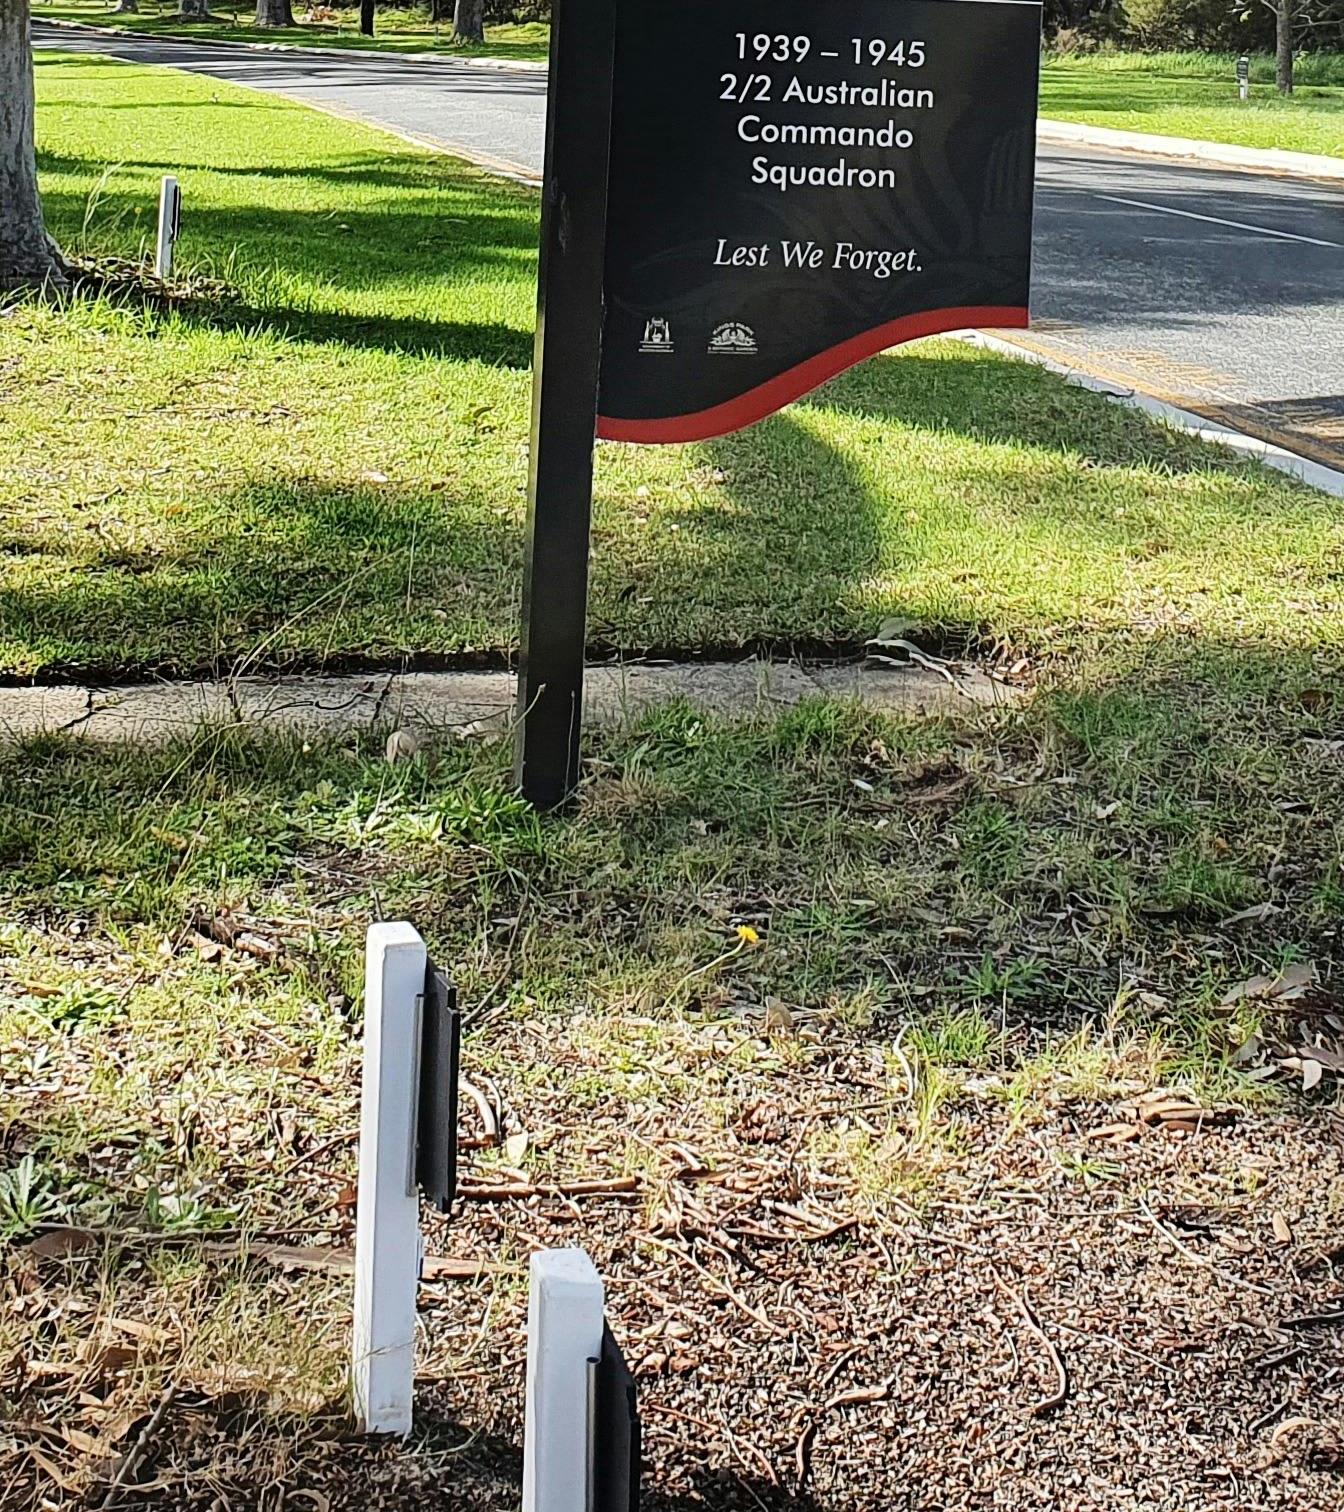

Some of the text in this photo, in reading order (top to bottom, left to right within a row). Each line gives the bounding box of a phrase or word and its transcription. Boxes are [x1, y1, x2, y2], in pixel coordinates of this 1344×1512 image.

[735, 32, 811, 63] 1939
[851, 38, 925, 68] 1945
[719, 73, 934, 109] 2/2 Australian
[737, 114, 914, 149] Commando
[751, 156, 895, 192] Squadron
[713, 238, 922, 279] Lest We Forget.
